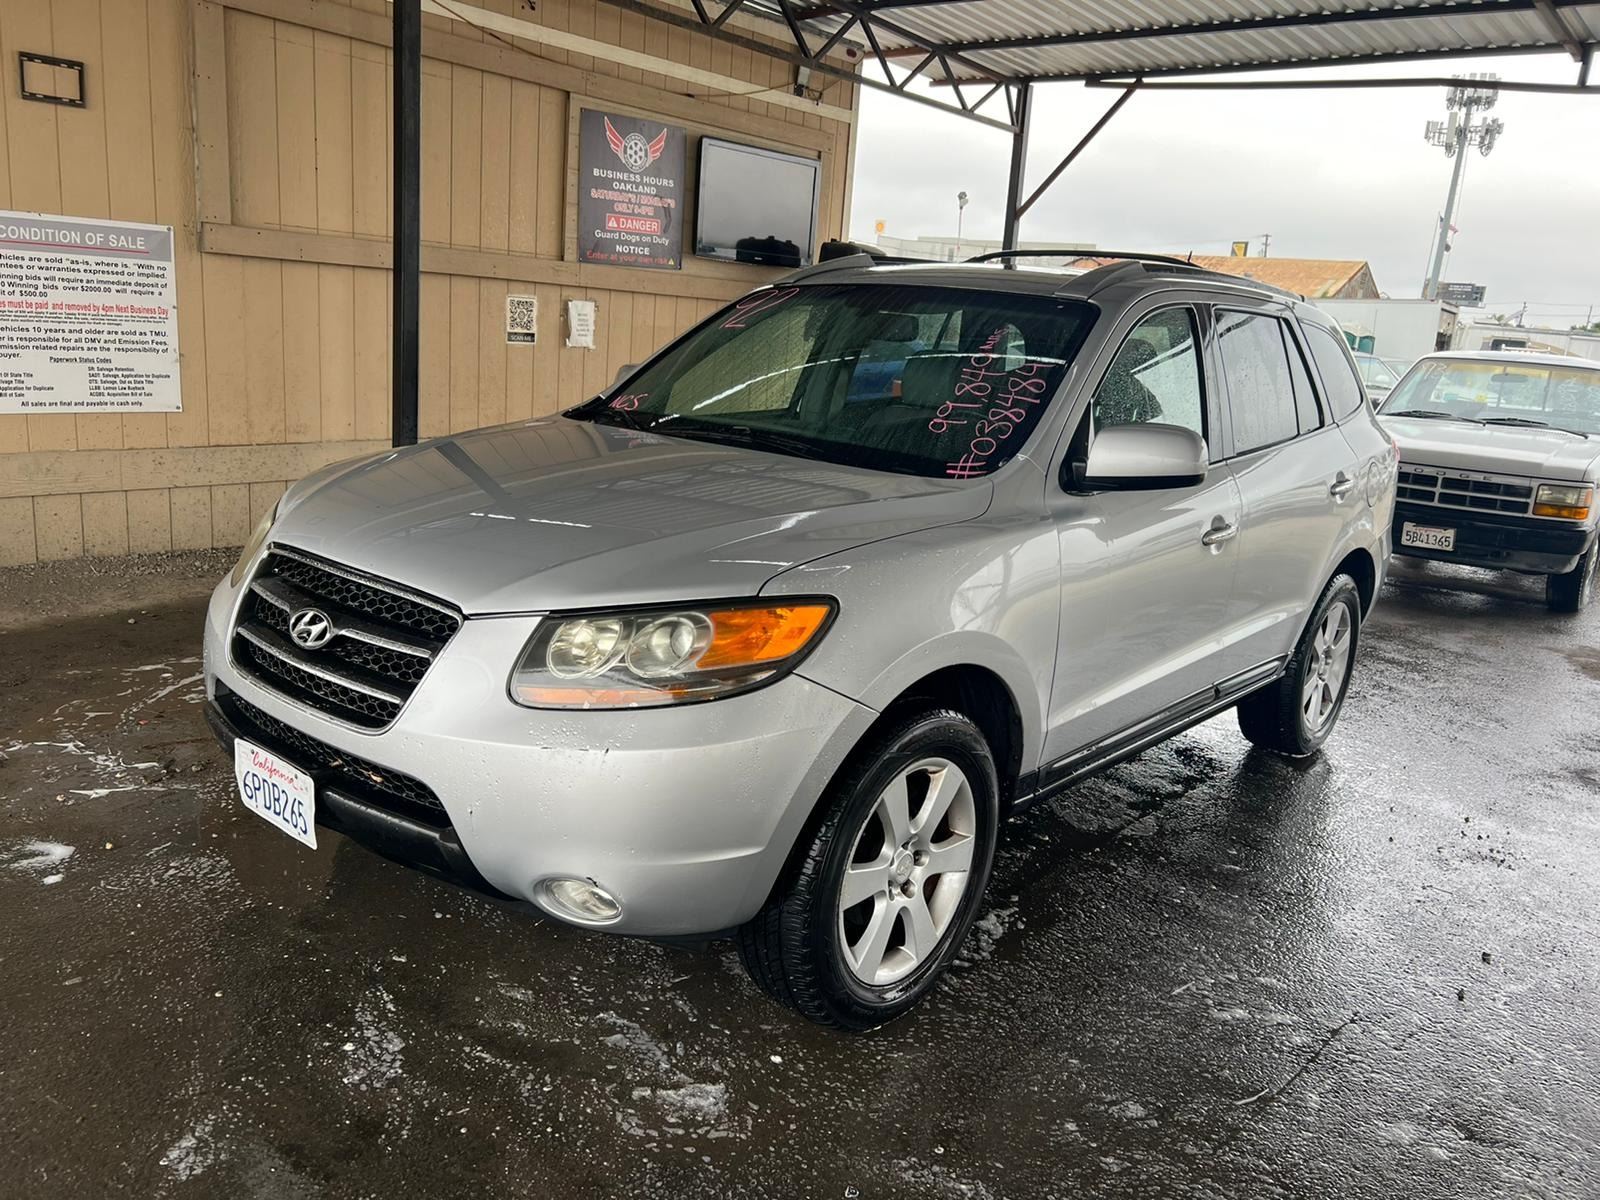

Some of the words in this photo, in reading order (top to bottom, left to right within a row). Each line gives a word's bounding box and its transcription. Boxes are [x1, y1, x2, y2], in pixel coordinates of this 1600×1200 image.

[593, 168, 641, 182] BUSINESS
[643, 176, 674, 188] HOURS
[612, 181, 657, 194] OAKLAND
[620, 218, 658, 232] DANGER
[0, 225, 80, 244] CONDITION
[85, 232, 104, 246] OF
[108, 234, 146, 249] SALE
[594, 229, 619, 239] Guard
[620, 232, 640, 243] Dogs
[652, 236, 670, 246] Duty
[616, 244, 650, 256] NOTICE
[137, 271, 167, 279] implied.
[7, 281, 39, 290] Winning
[26, 301, 33, 309] be
[35, 301, 48, 310] paid
[52, 302, 63, 310] and
[93, 304, 100, 314] by
[116, 304, 129, 312] Next
[130, 305, 156, 314] Business
[158, 306, 168, 317] Day
[946, 363, 1056, 480] #038484
[1405, 530, 1451, 548] 5B41365
[252, 751, 295, 785] California
[243, 770, 308, 835] 6PDB265
